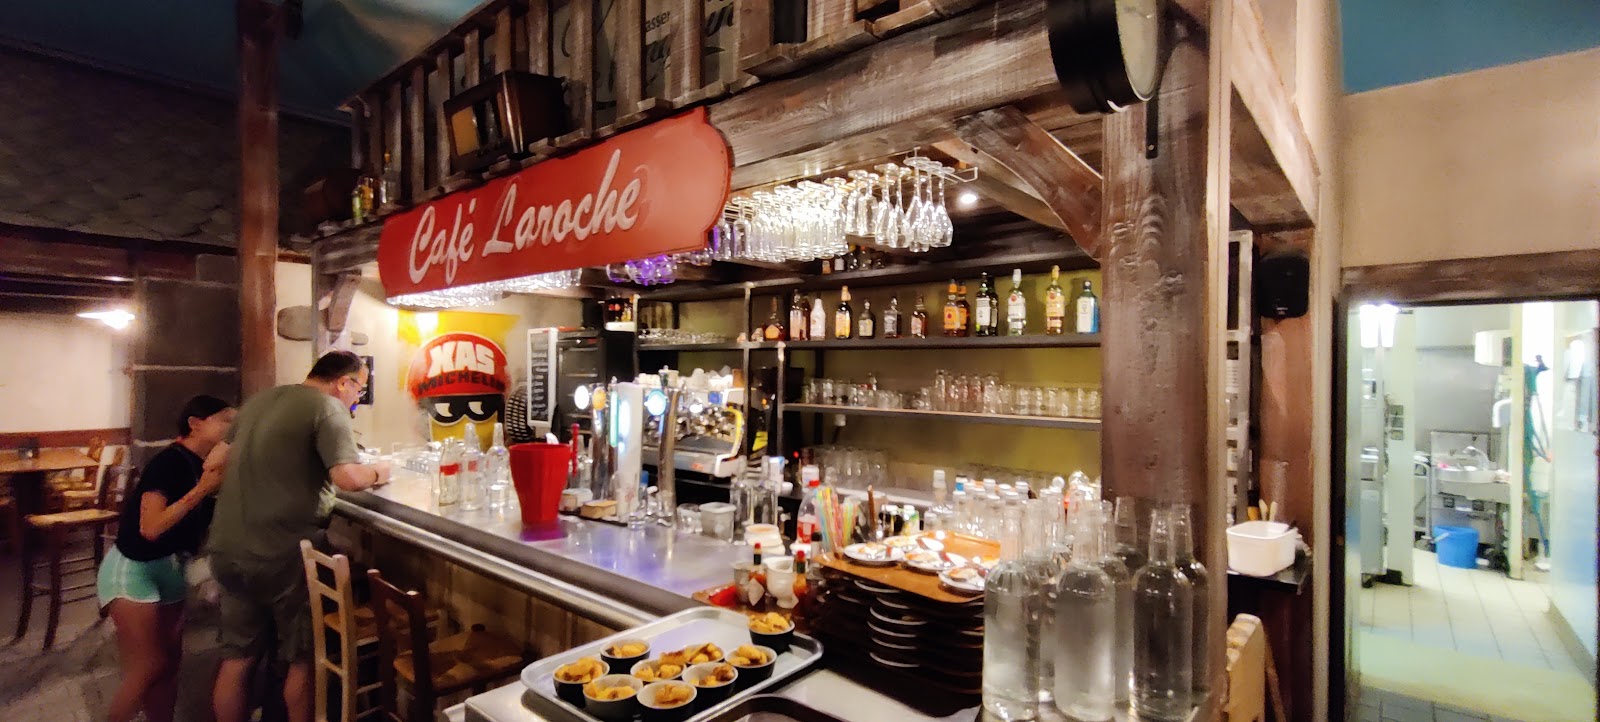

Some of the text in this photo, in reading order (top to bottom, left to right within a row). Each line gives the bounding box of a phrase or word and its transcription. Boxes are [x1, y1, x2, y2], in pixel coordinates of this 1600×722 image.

[408, 148, 641, 284] Café Laroche
[427, 340, 496, 378] XAS
[418, 370, 506, 396] MICHELIN
